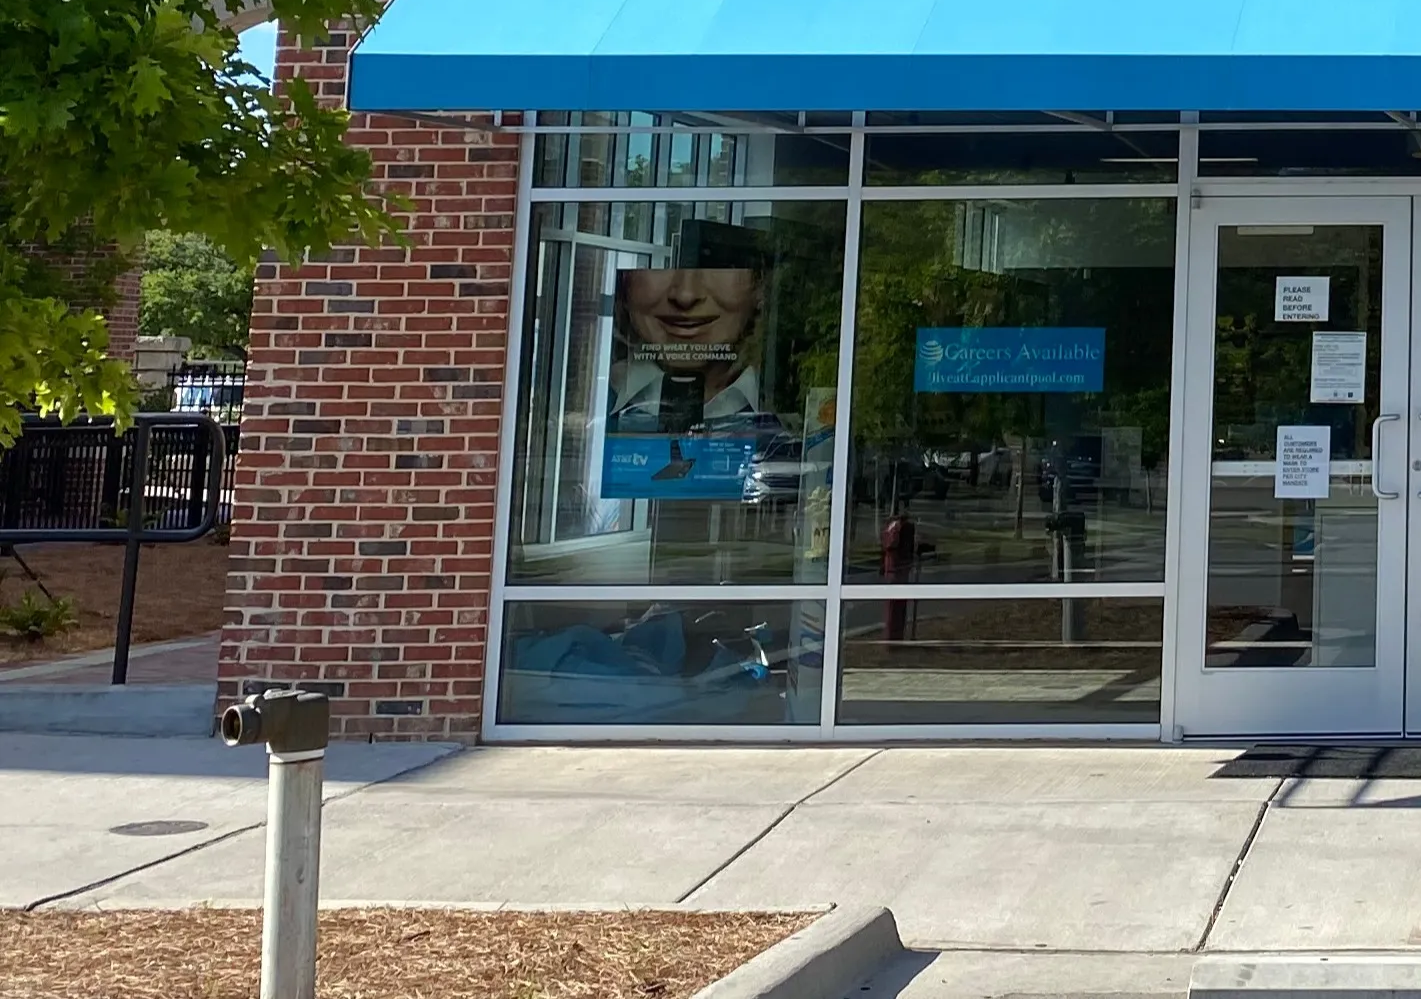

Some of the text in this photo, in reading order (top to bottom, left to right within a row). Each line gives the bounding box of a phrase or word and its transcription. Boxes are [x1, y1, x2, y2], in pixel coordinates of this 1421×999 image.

[641, 343, 731, 351] FIND WHAT YOU LOVE
[633, 352, 657, 360] WITH
[691, 352, 738, 360] COMMAND
[944, 343, 1101, 361] Careers Available
